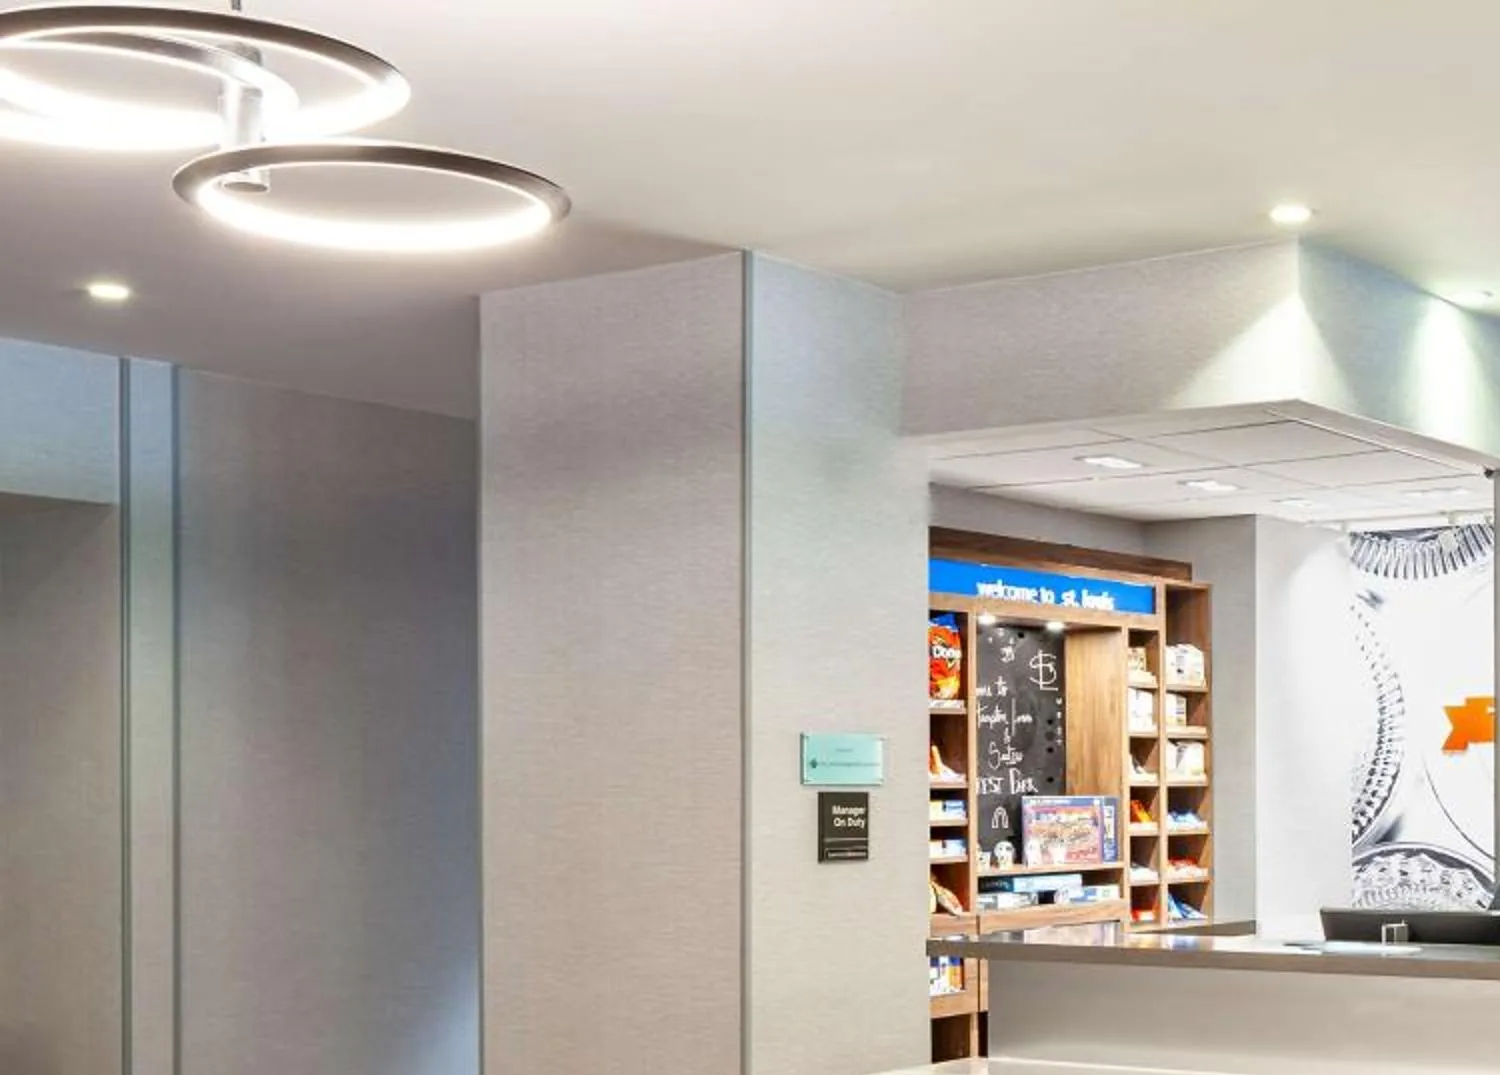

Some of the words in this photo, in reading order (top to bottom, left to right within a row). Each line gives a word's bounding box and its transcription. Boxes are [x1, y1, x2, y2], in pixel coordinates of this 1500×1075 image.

[976, 579, 1038, 604] welcome
[1039, 586, 1056, 604] to
[832, 804, 865, 816] Manager
[833, 817, 846, 827] On
[847, 817, 865, 828] Duty
